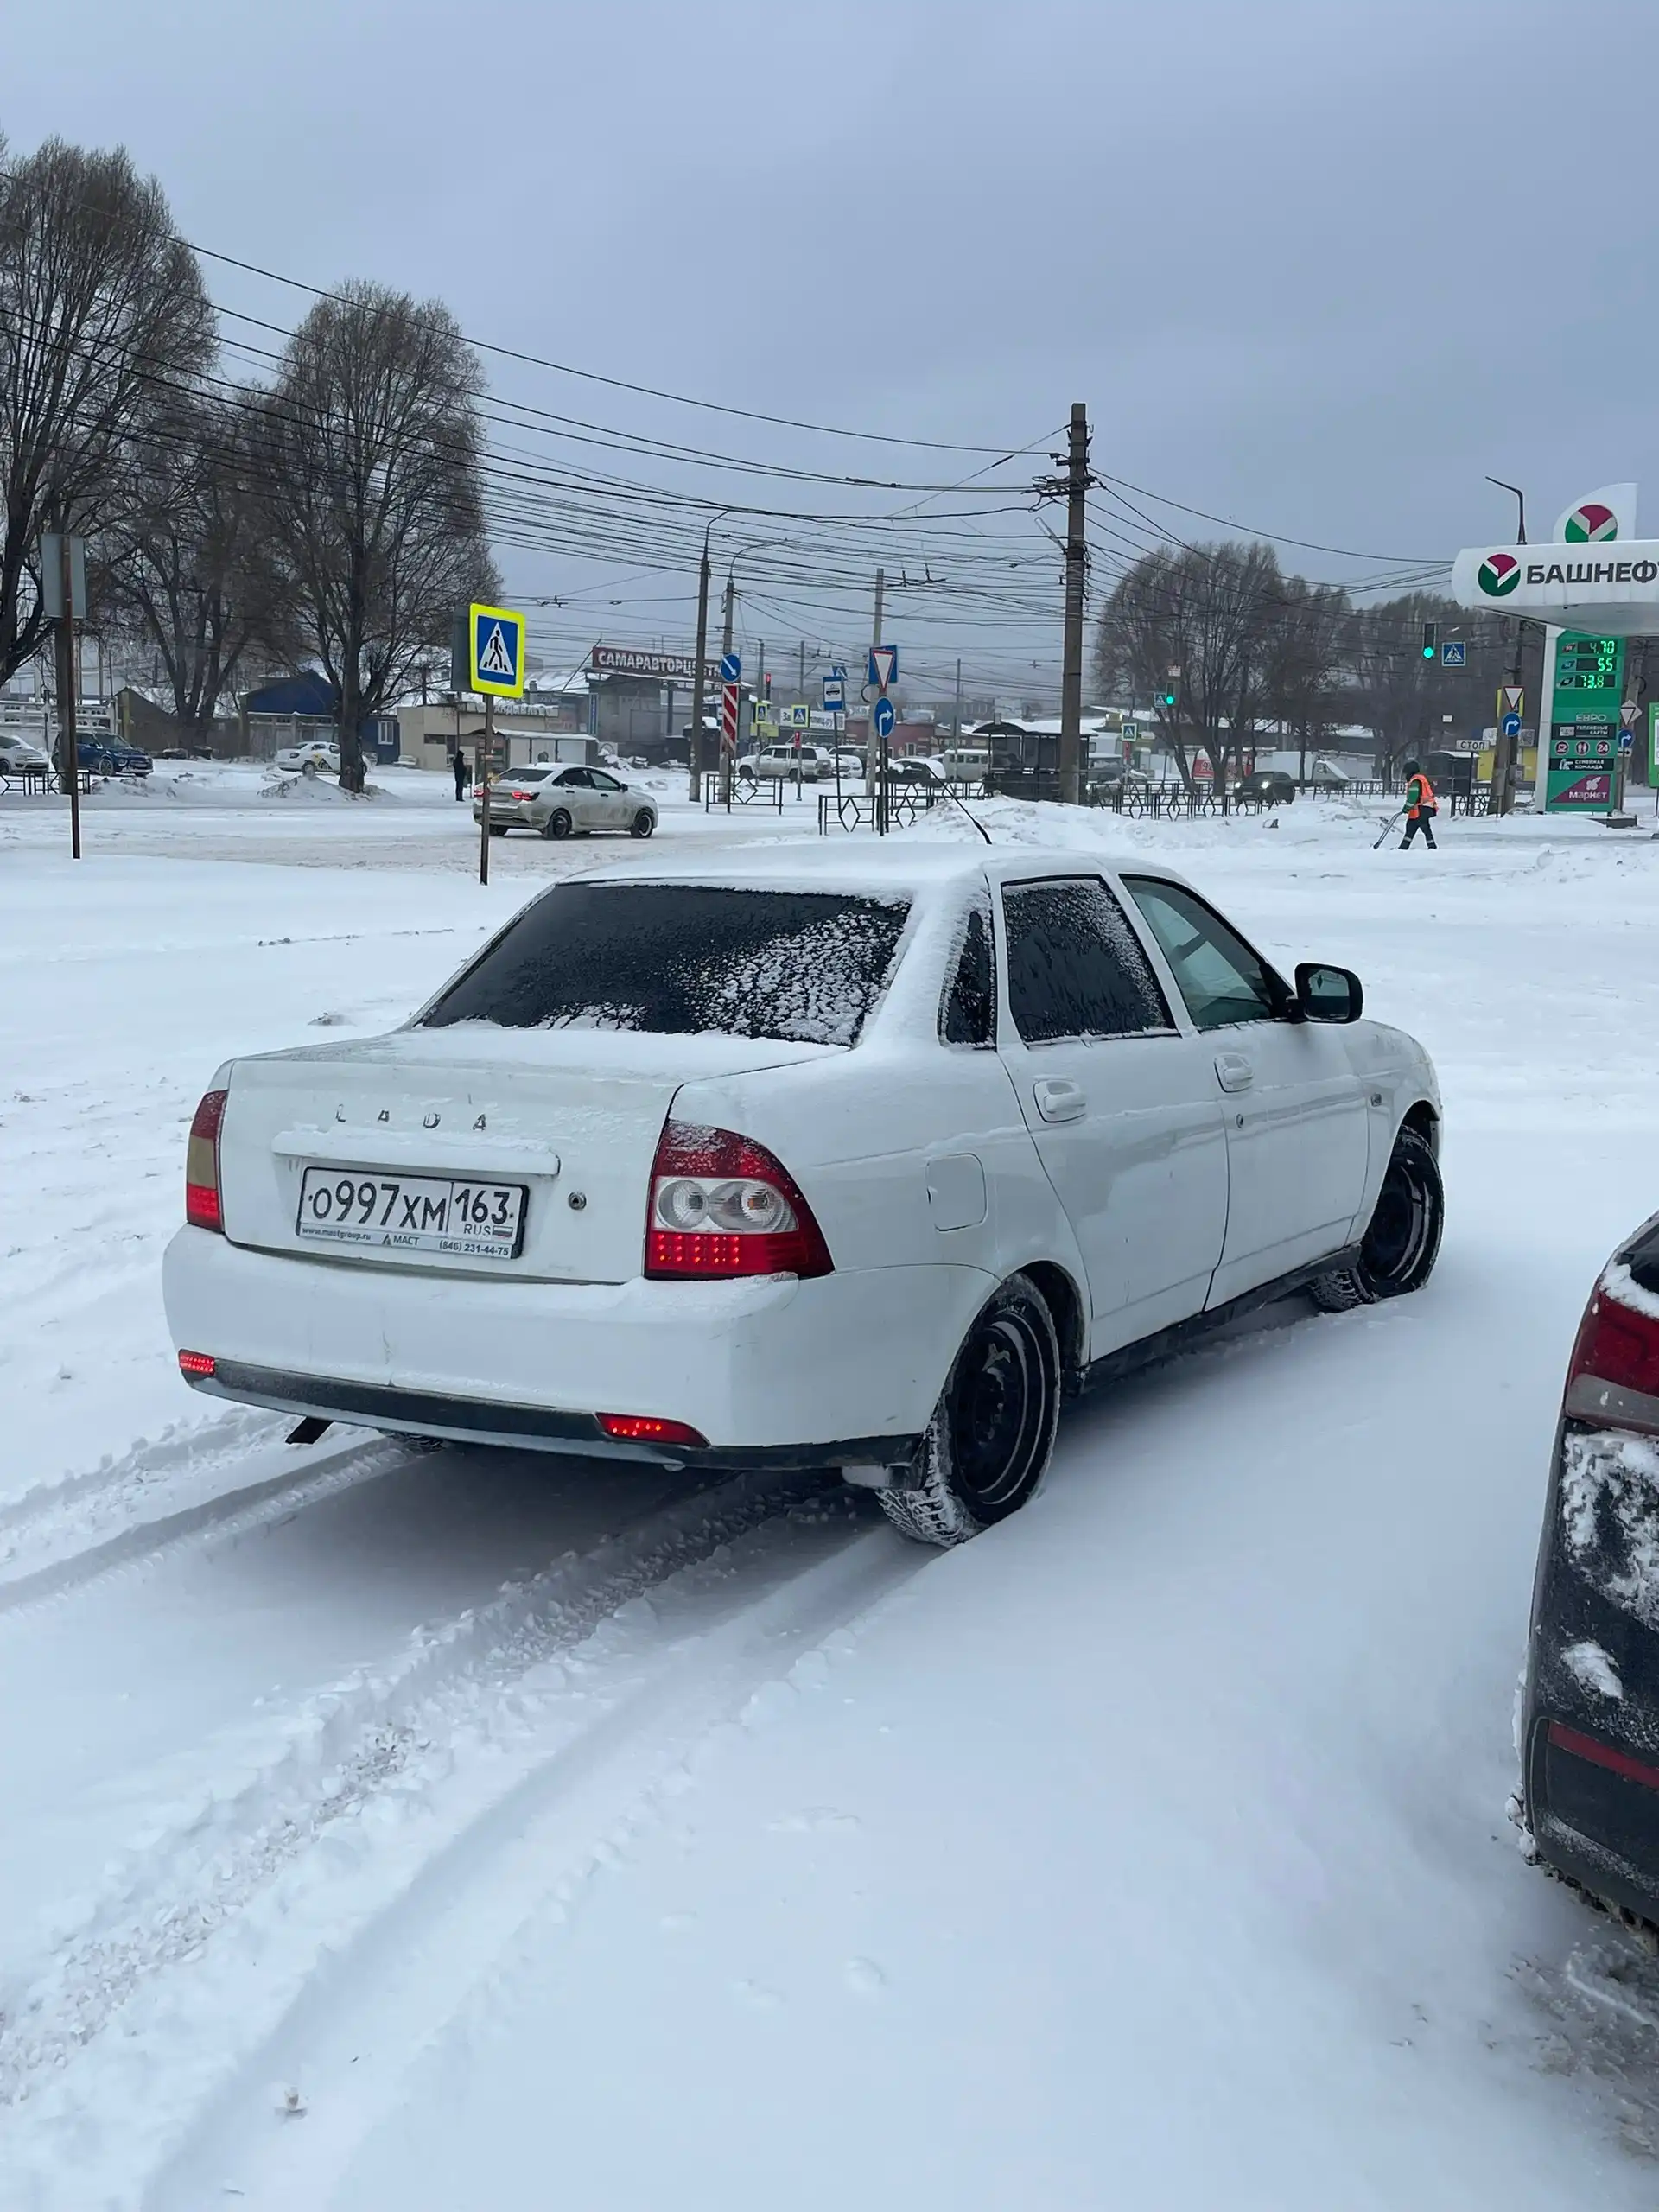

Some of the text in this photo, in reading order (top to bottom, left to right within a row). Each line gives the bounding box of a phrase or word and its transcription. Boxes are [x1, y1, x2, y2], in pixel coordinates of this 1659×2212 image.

[1527, 560, 1659, 584] БАШНЕФ
[1460, 741, 1485, 750] СТОП
[335, 1103, 486, 1132] LADA
[312, 1179, 510, 1232] О997ХМ 163
[463, 1223, 491, 1236] RUS
[393, 1234, 420, 1246] МАСТ
[464, 1243, 509, 1256] 231-44-75
